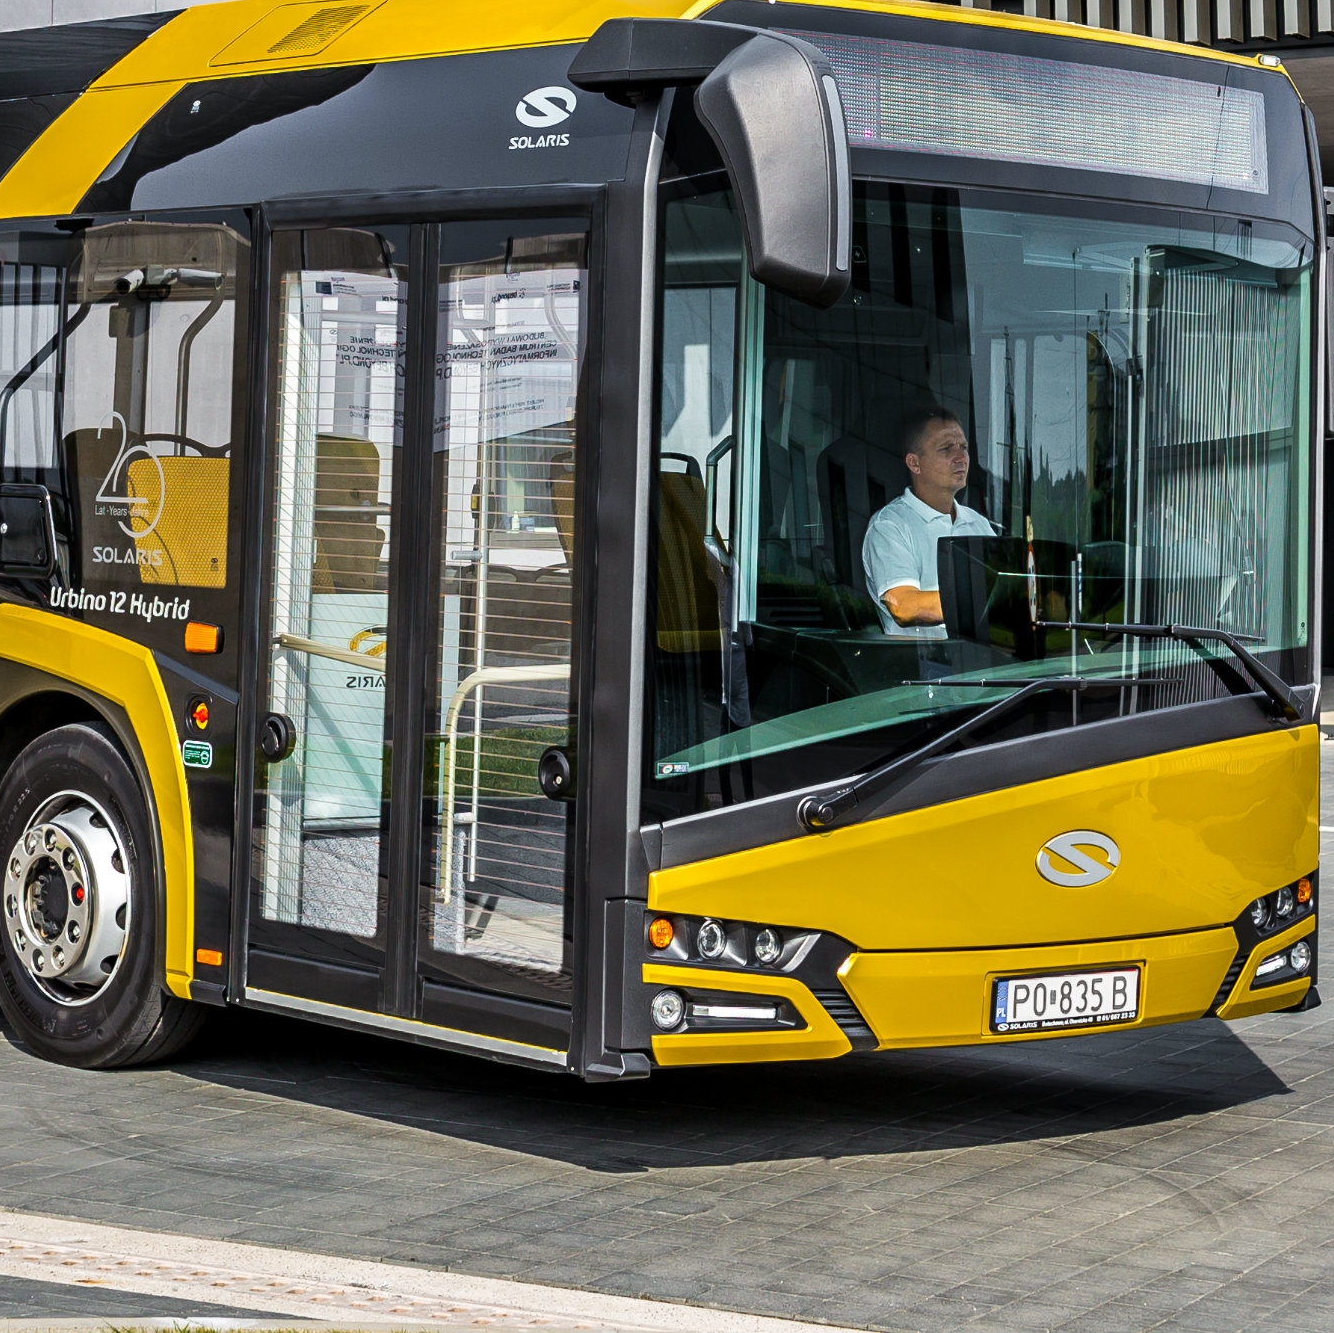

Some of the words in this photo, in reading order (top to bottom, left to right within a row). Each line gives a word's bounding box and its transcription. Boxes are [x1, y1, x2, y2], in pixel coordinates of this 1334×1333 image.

[508, 133, 570, 150] SOLARIS
[92, 546, 163, 566] SOLARIS
[50, 586, 107, 611] Urbino
[110, 591, 127, 613] 12
[129, 593, 190, 623] Hybrid
[1059, 977, 1104, 1015] 835
[1009, 1021, 1038, 1030] SOLARIS
